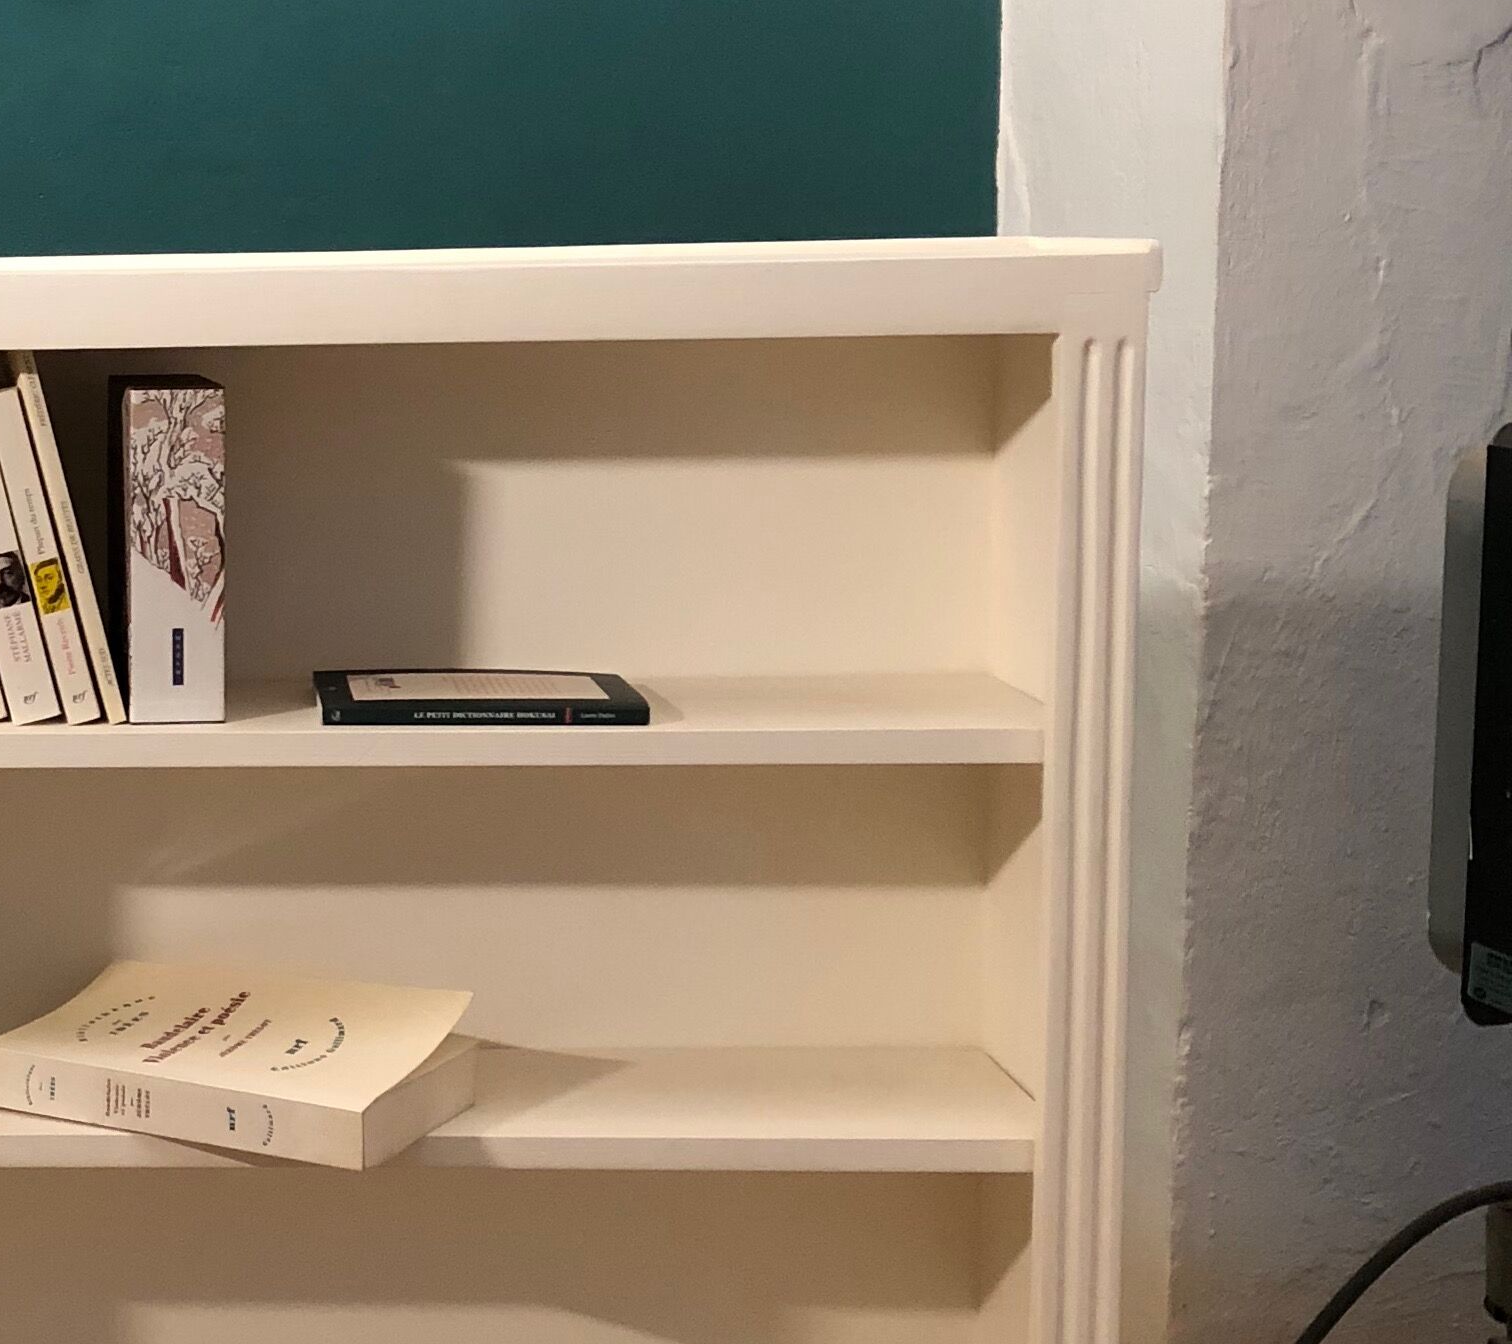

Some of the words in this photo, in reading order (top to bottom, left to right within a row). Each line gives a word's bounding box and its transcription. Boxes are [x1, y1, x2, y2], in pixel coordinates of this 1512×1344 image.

[140, 1007, 211, 1049] Baudelaire
[142, 1035, 201, 1063] Violence
[198, 1026, 215, 1035] et
[211, 991, 251, 1026] poésie
[285, 1039, 309, 1054] nrf
[226, 1106, 236, 1131] nrf
